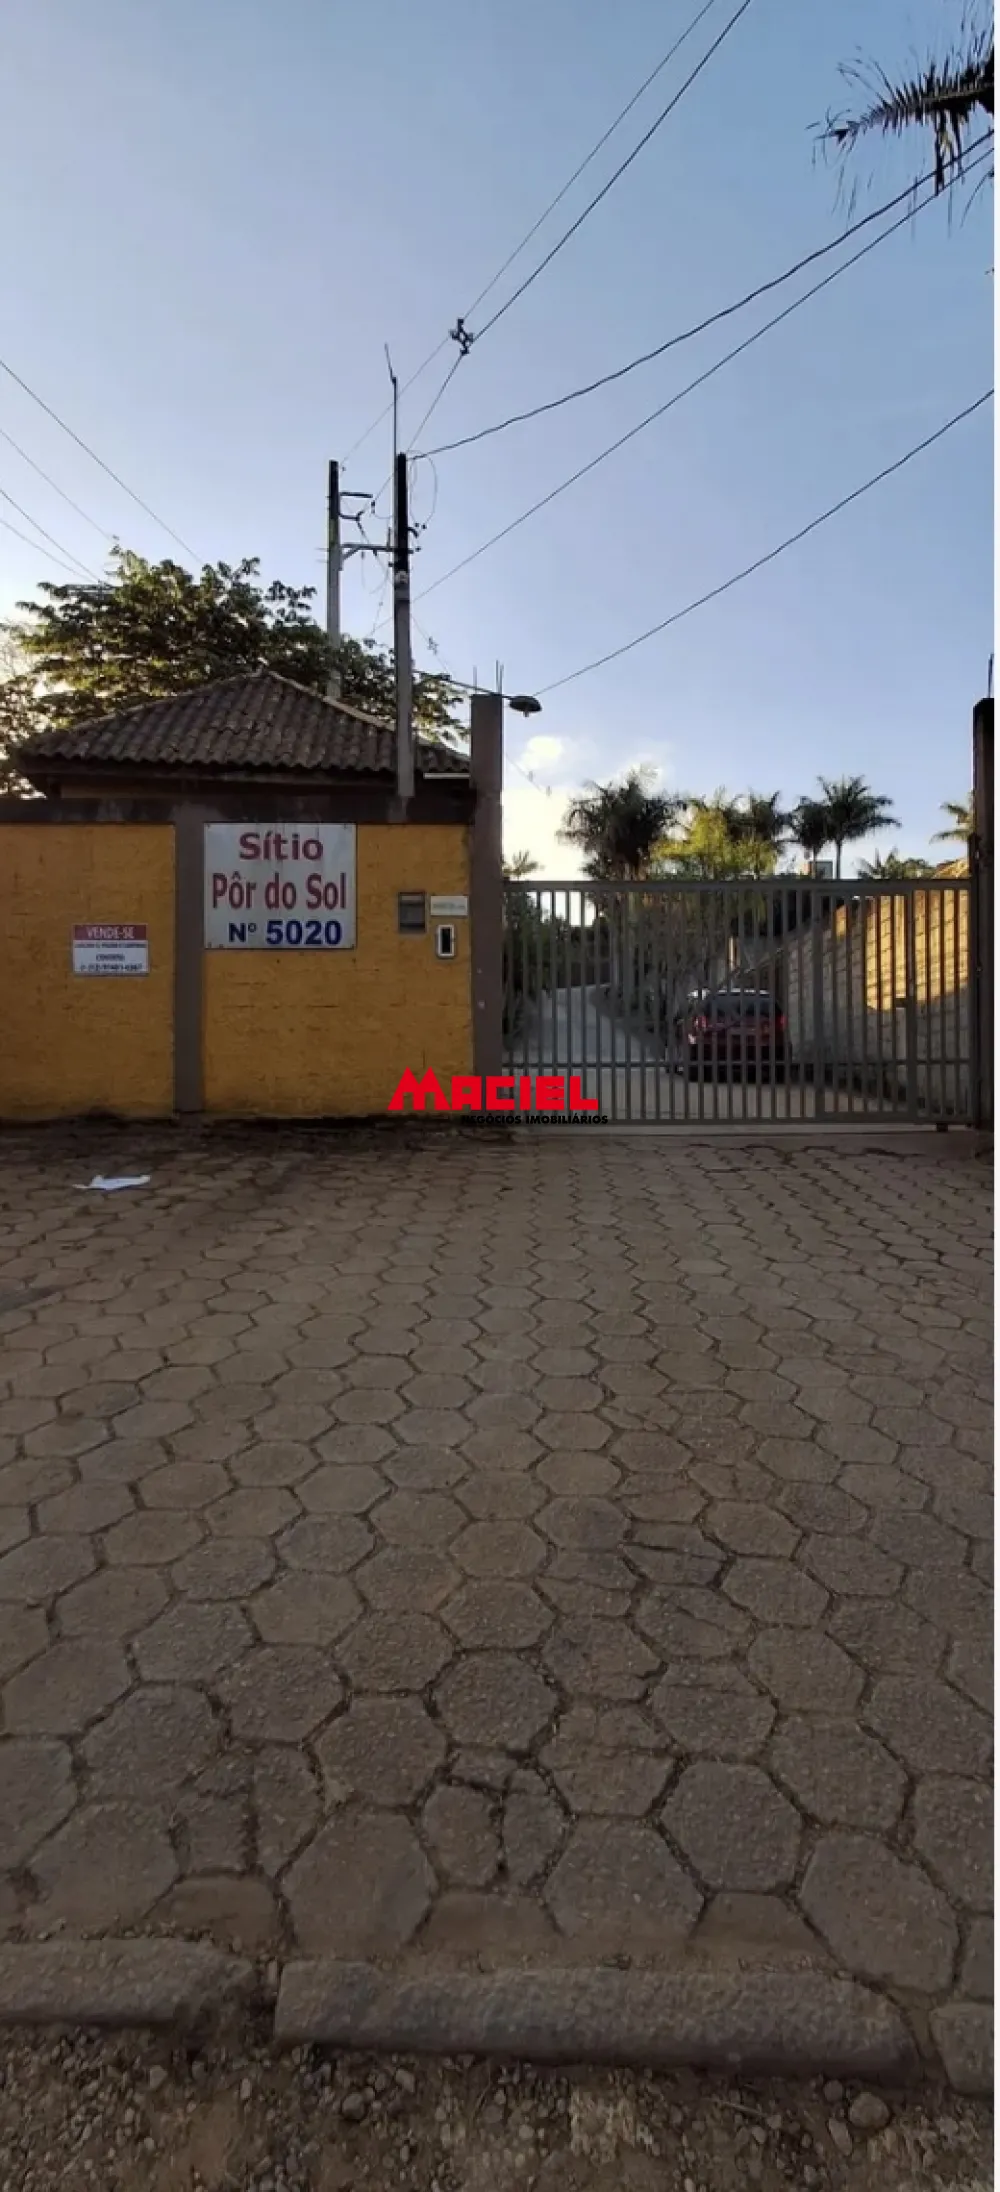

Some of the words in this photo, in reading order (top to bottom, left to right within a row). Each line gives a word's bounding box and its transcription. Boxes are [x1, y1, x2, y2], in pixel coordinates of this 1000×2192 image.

[238, 830, 324, 860] Sítio
[212, 870, 257, 910] Pôr
[264, 871, 297, 910] do
[305, 871, 347, 910] Sol
[86, 926, 135, 939] VENDE-SE
[265, 918, 343, 946] 5020
